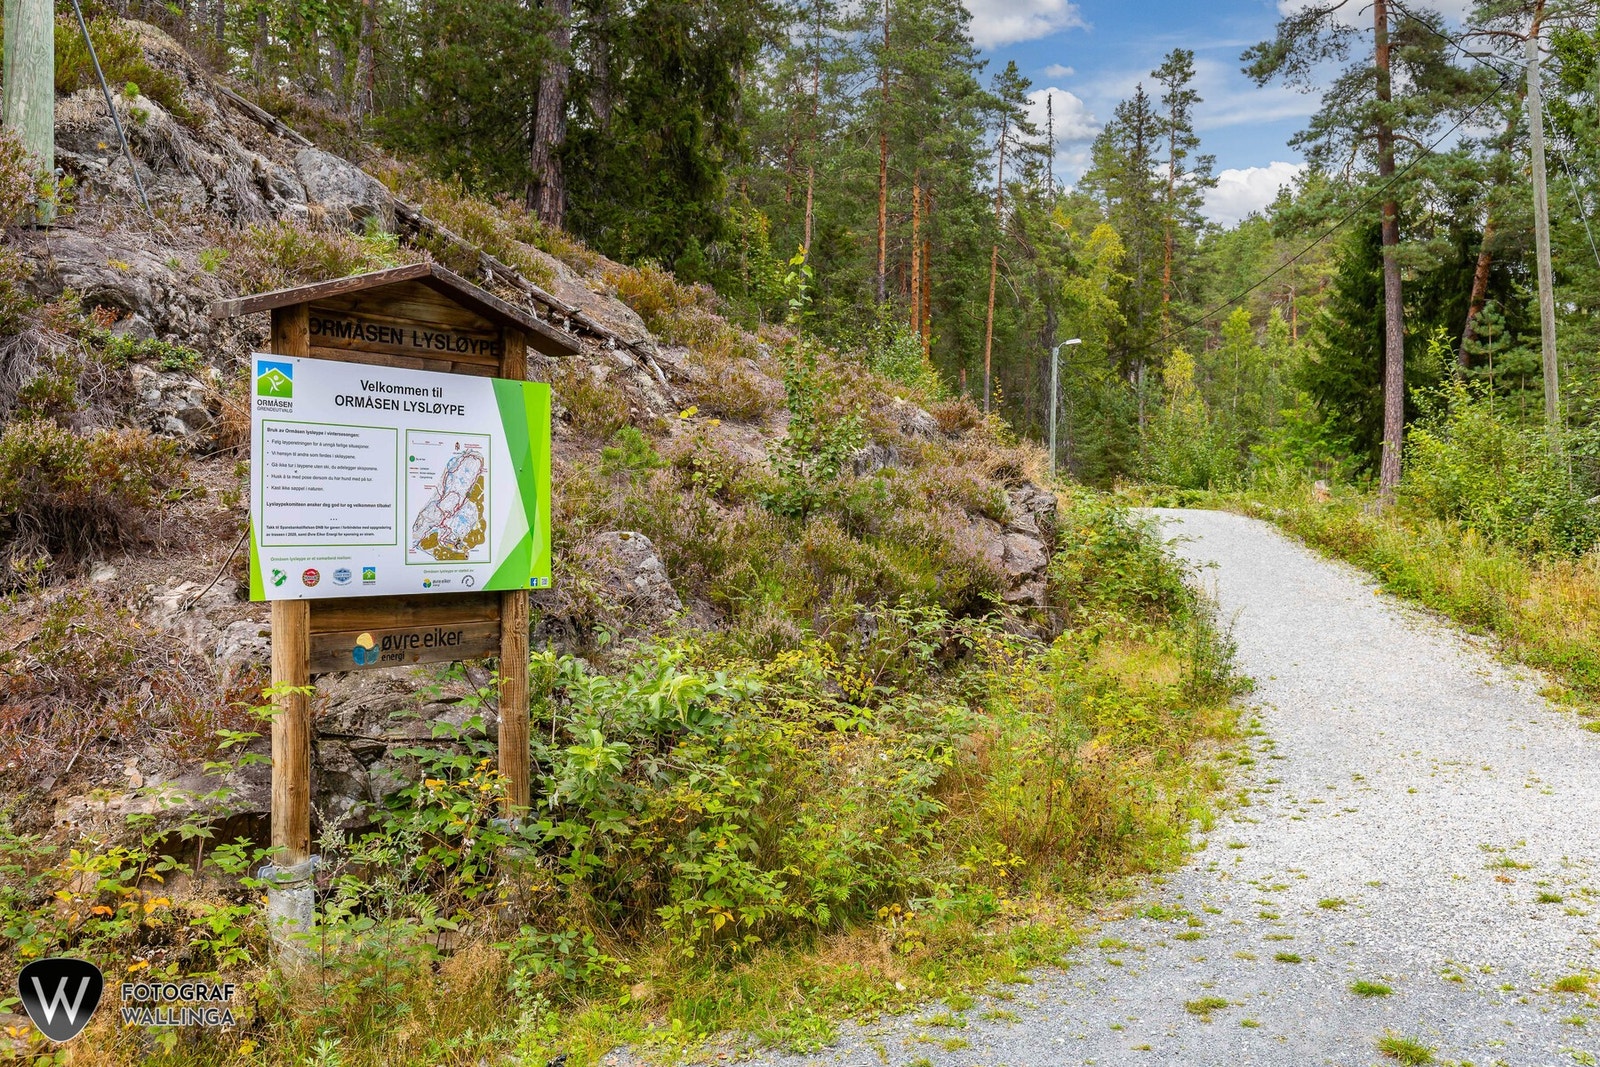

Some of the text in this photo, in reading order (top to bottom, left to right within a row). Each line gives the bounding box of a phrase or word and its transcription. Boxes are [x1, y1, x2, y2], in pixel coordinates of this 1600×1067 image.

[308, 317, 500, 356] ORMÅSEN LYSLØYPE
[360, 380, 442, 398] Velkommen til
[257, 399, 293, 408] ORMÅSEN
[335, 394, 465, 416] ORMÅSEN LYSLØYPE
[382, 628, 463, 651] øvre eiker
[382, 651, 405, 661] energi
